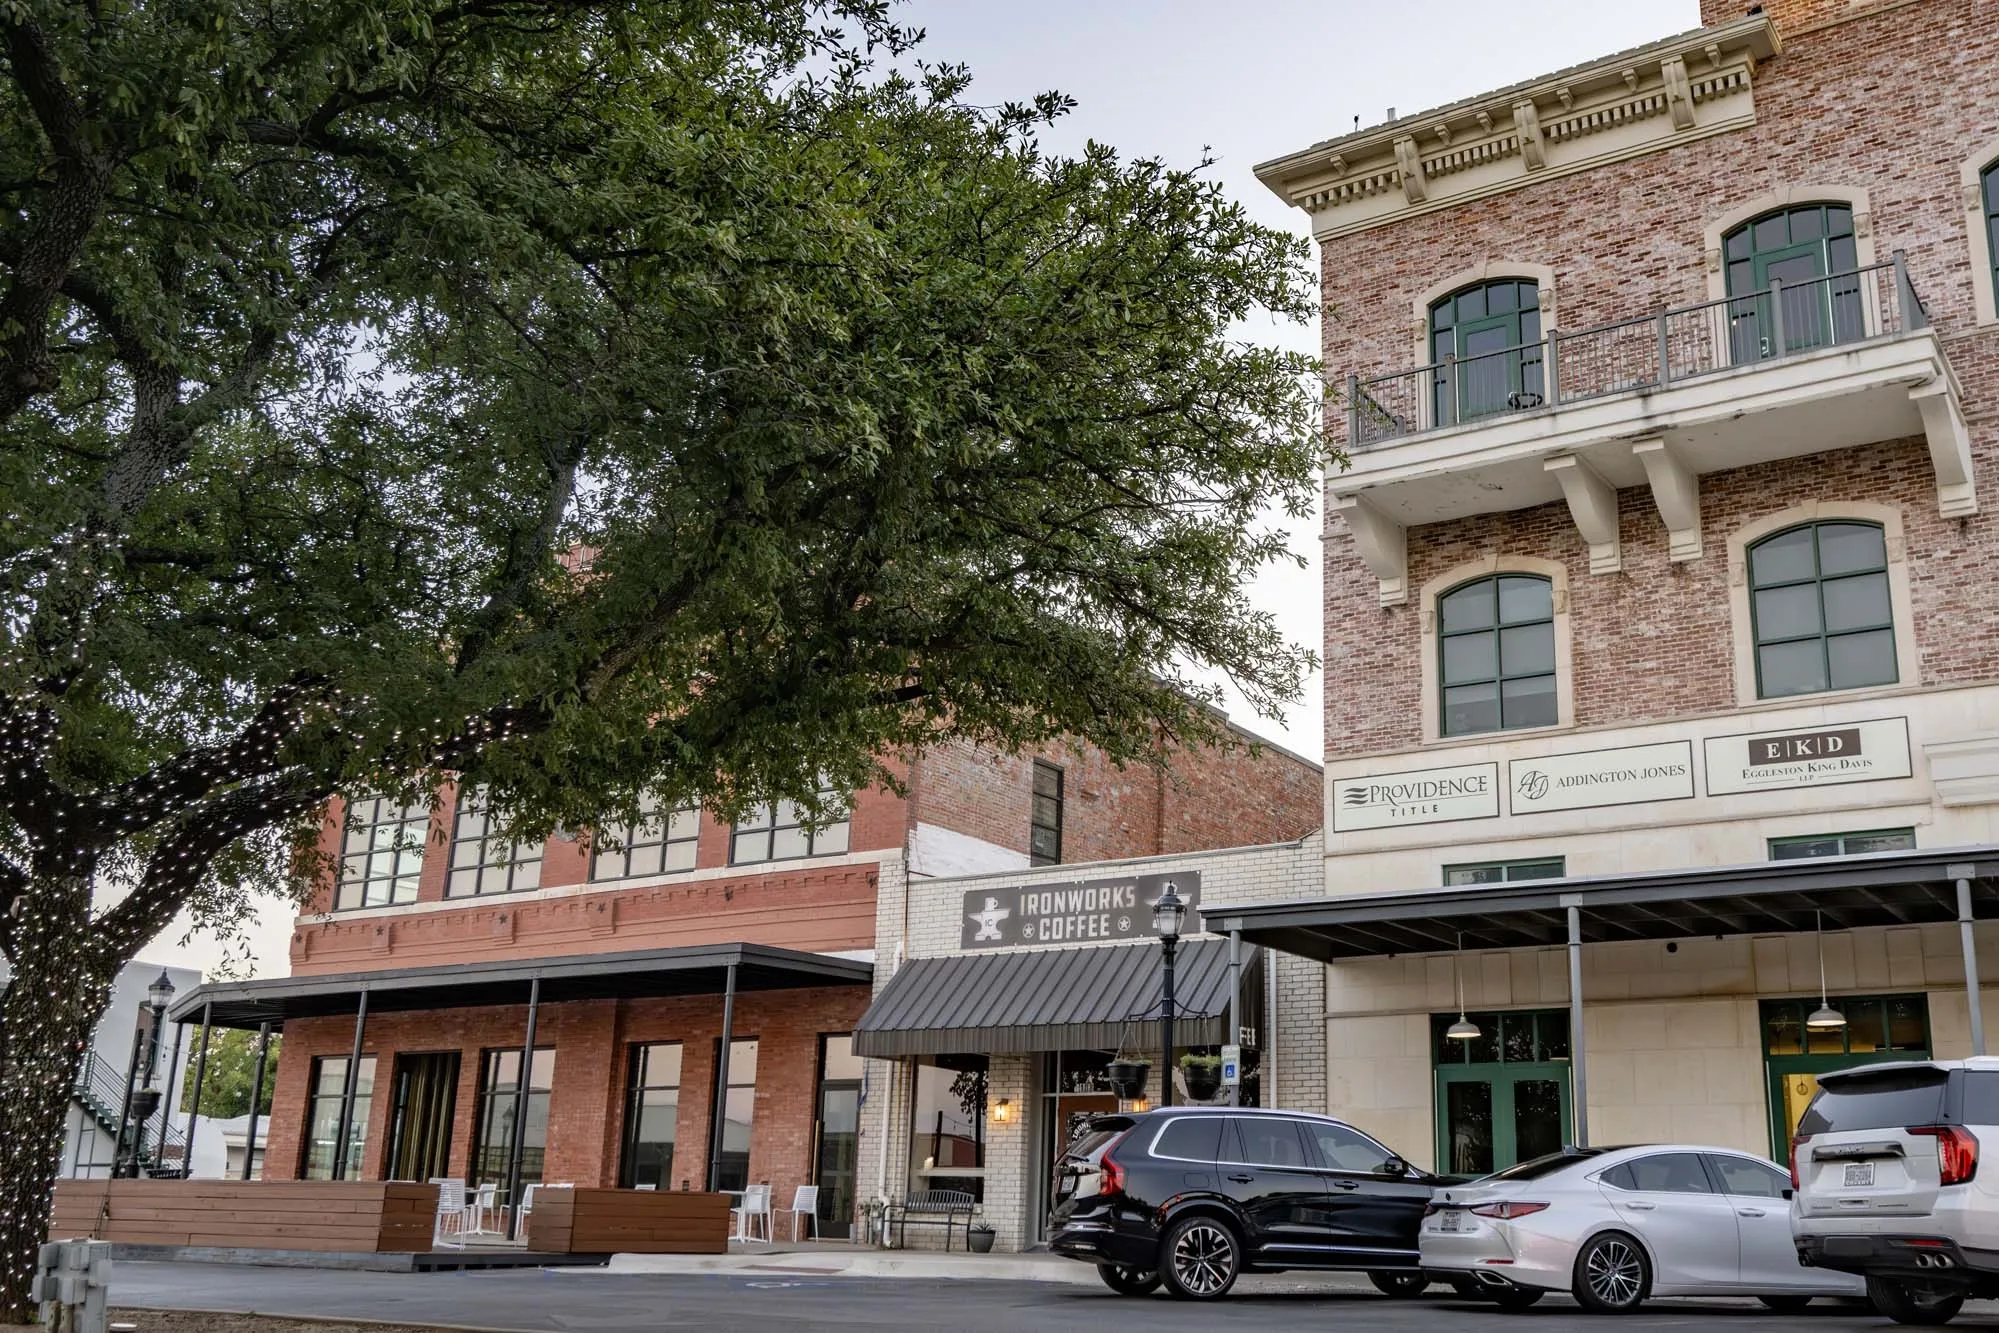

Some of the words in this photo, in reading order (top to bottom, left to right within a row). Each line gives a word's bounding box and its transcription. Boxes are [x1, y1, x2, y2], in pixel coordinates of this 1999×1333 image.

[1556, 768, 1637, 789] ADDINGTON
[1641, 764, 1686, 780] JONES
[1808, 762, 1837, 773] KING
[1840, 759, 1873, 771] DAVIS
[1370, 776, 1489, 807] PROVIDENCE
[1391, 804, 1439, 817] TITLE
[1020, 885, 1137, 916] IRONWORKS
[1039, 914, 1111, 940] COFFEE
